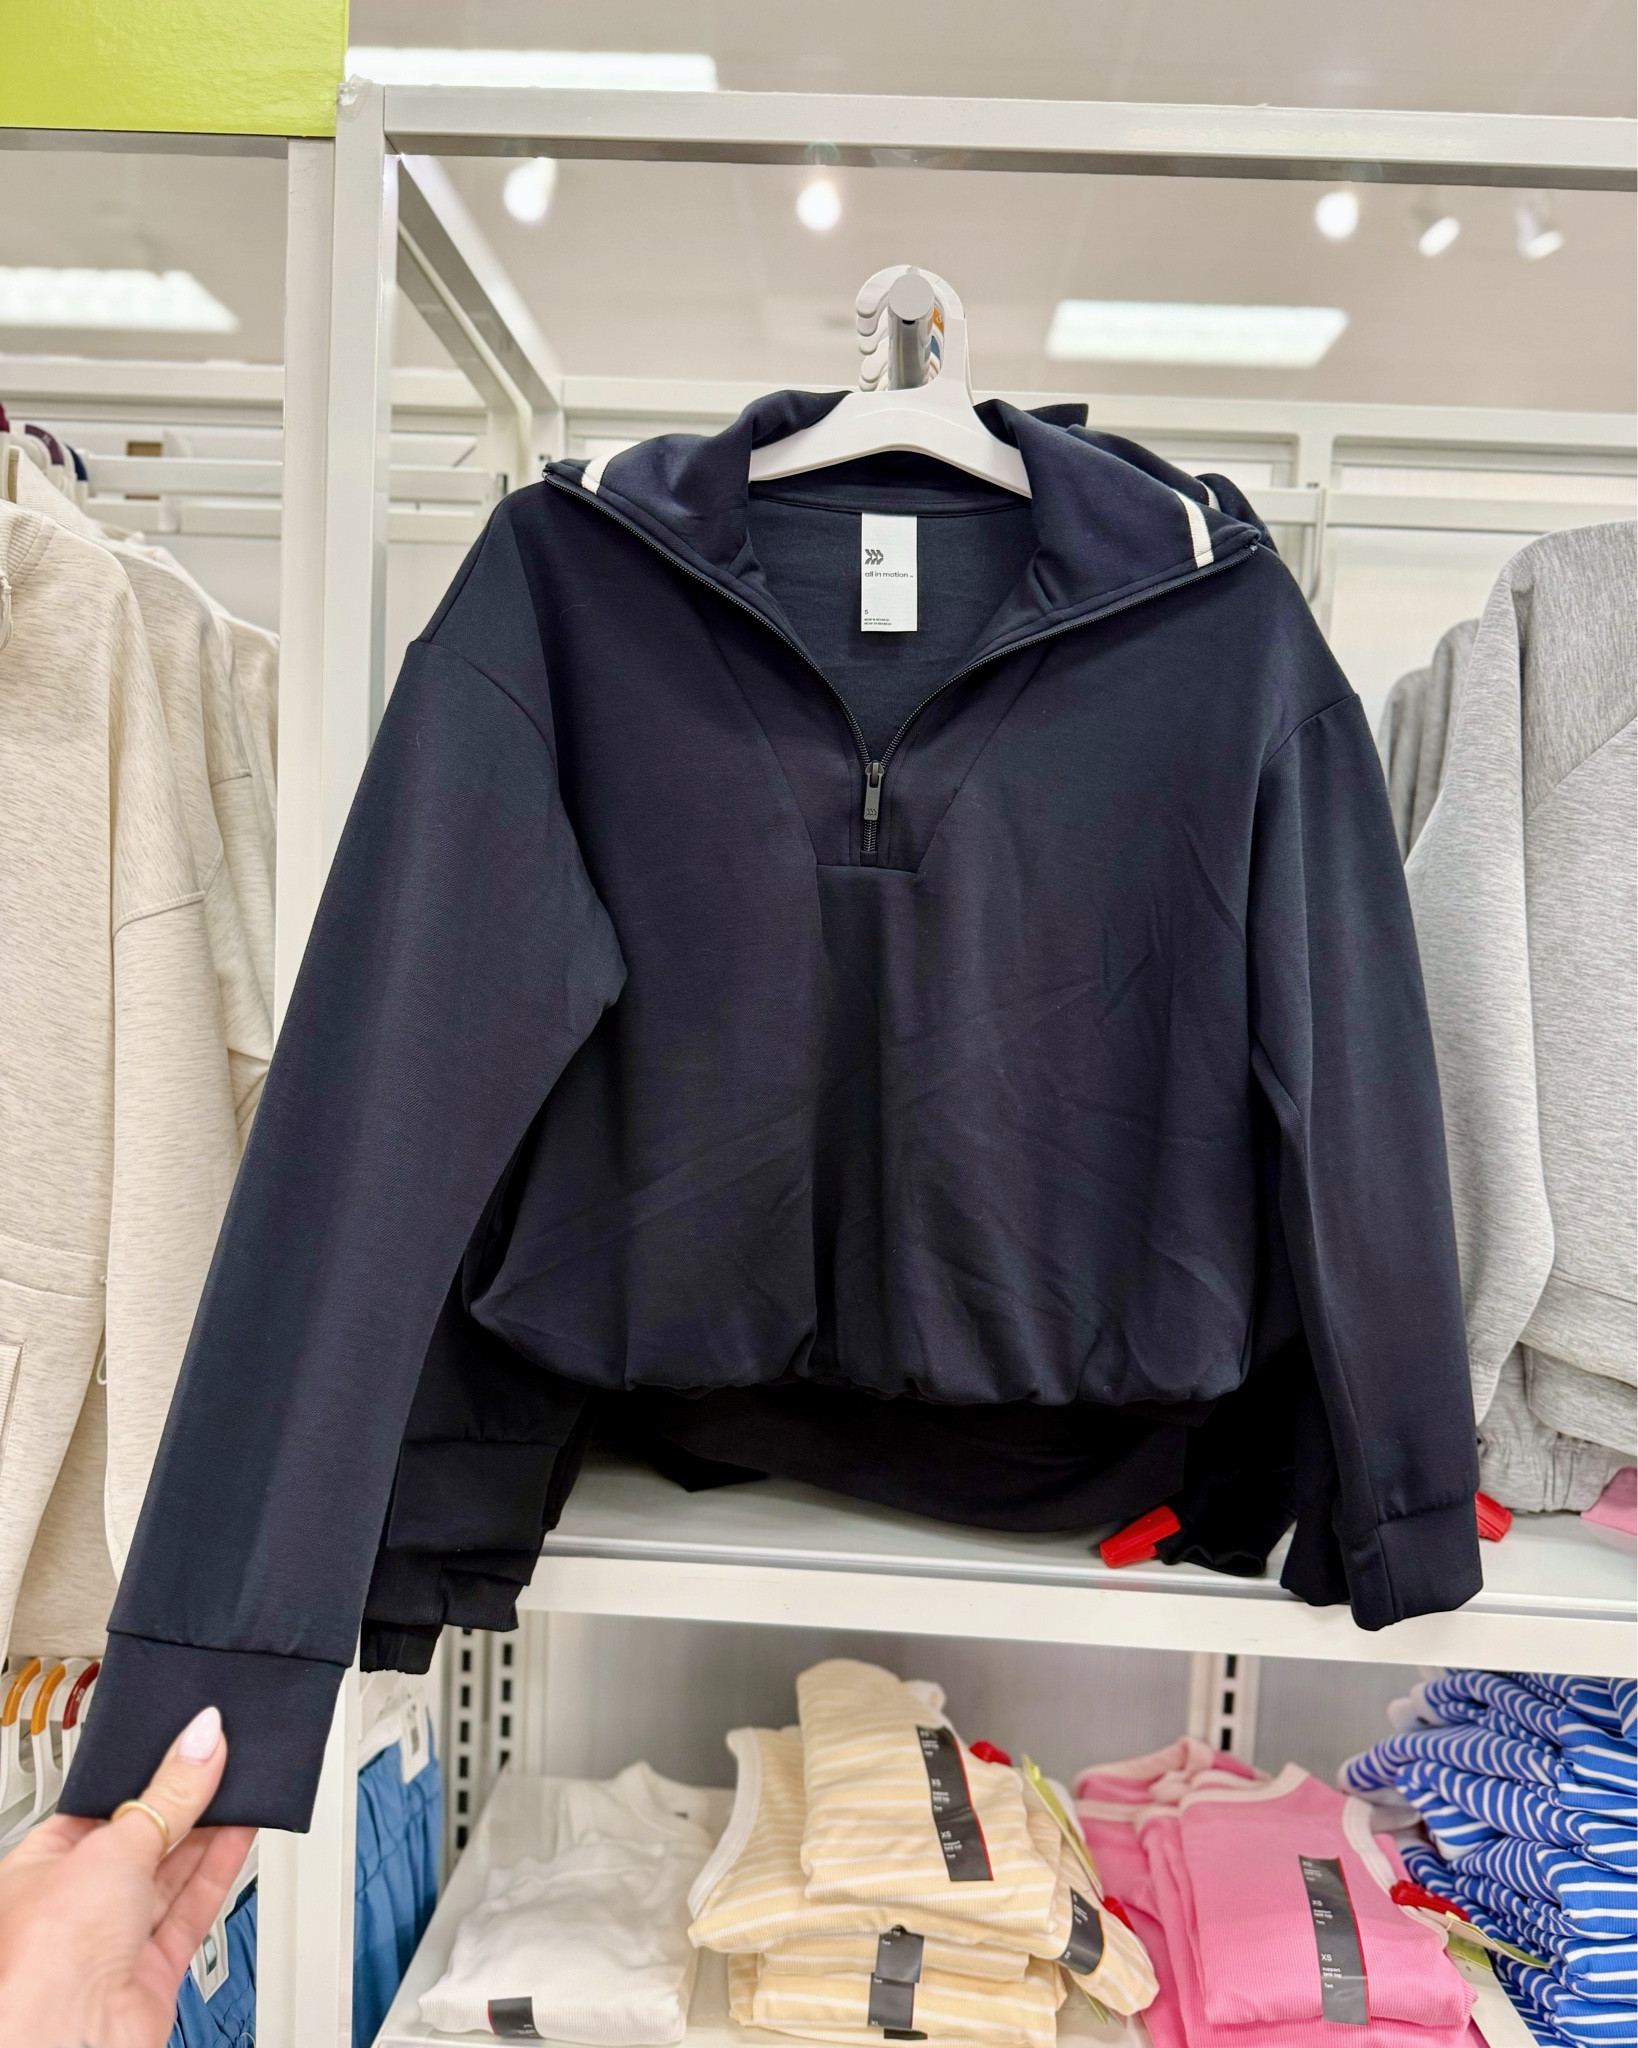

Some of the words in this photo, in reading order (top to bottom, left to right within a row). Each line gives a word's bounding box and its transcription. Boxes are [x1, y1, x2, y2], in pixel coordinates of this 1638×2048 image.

[941, 1830, 952, 1839] XS
[1312, 1899, 1323, 1907] XS
[1321, 1953, 1332, 1961] XS
